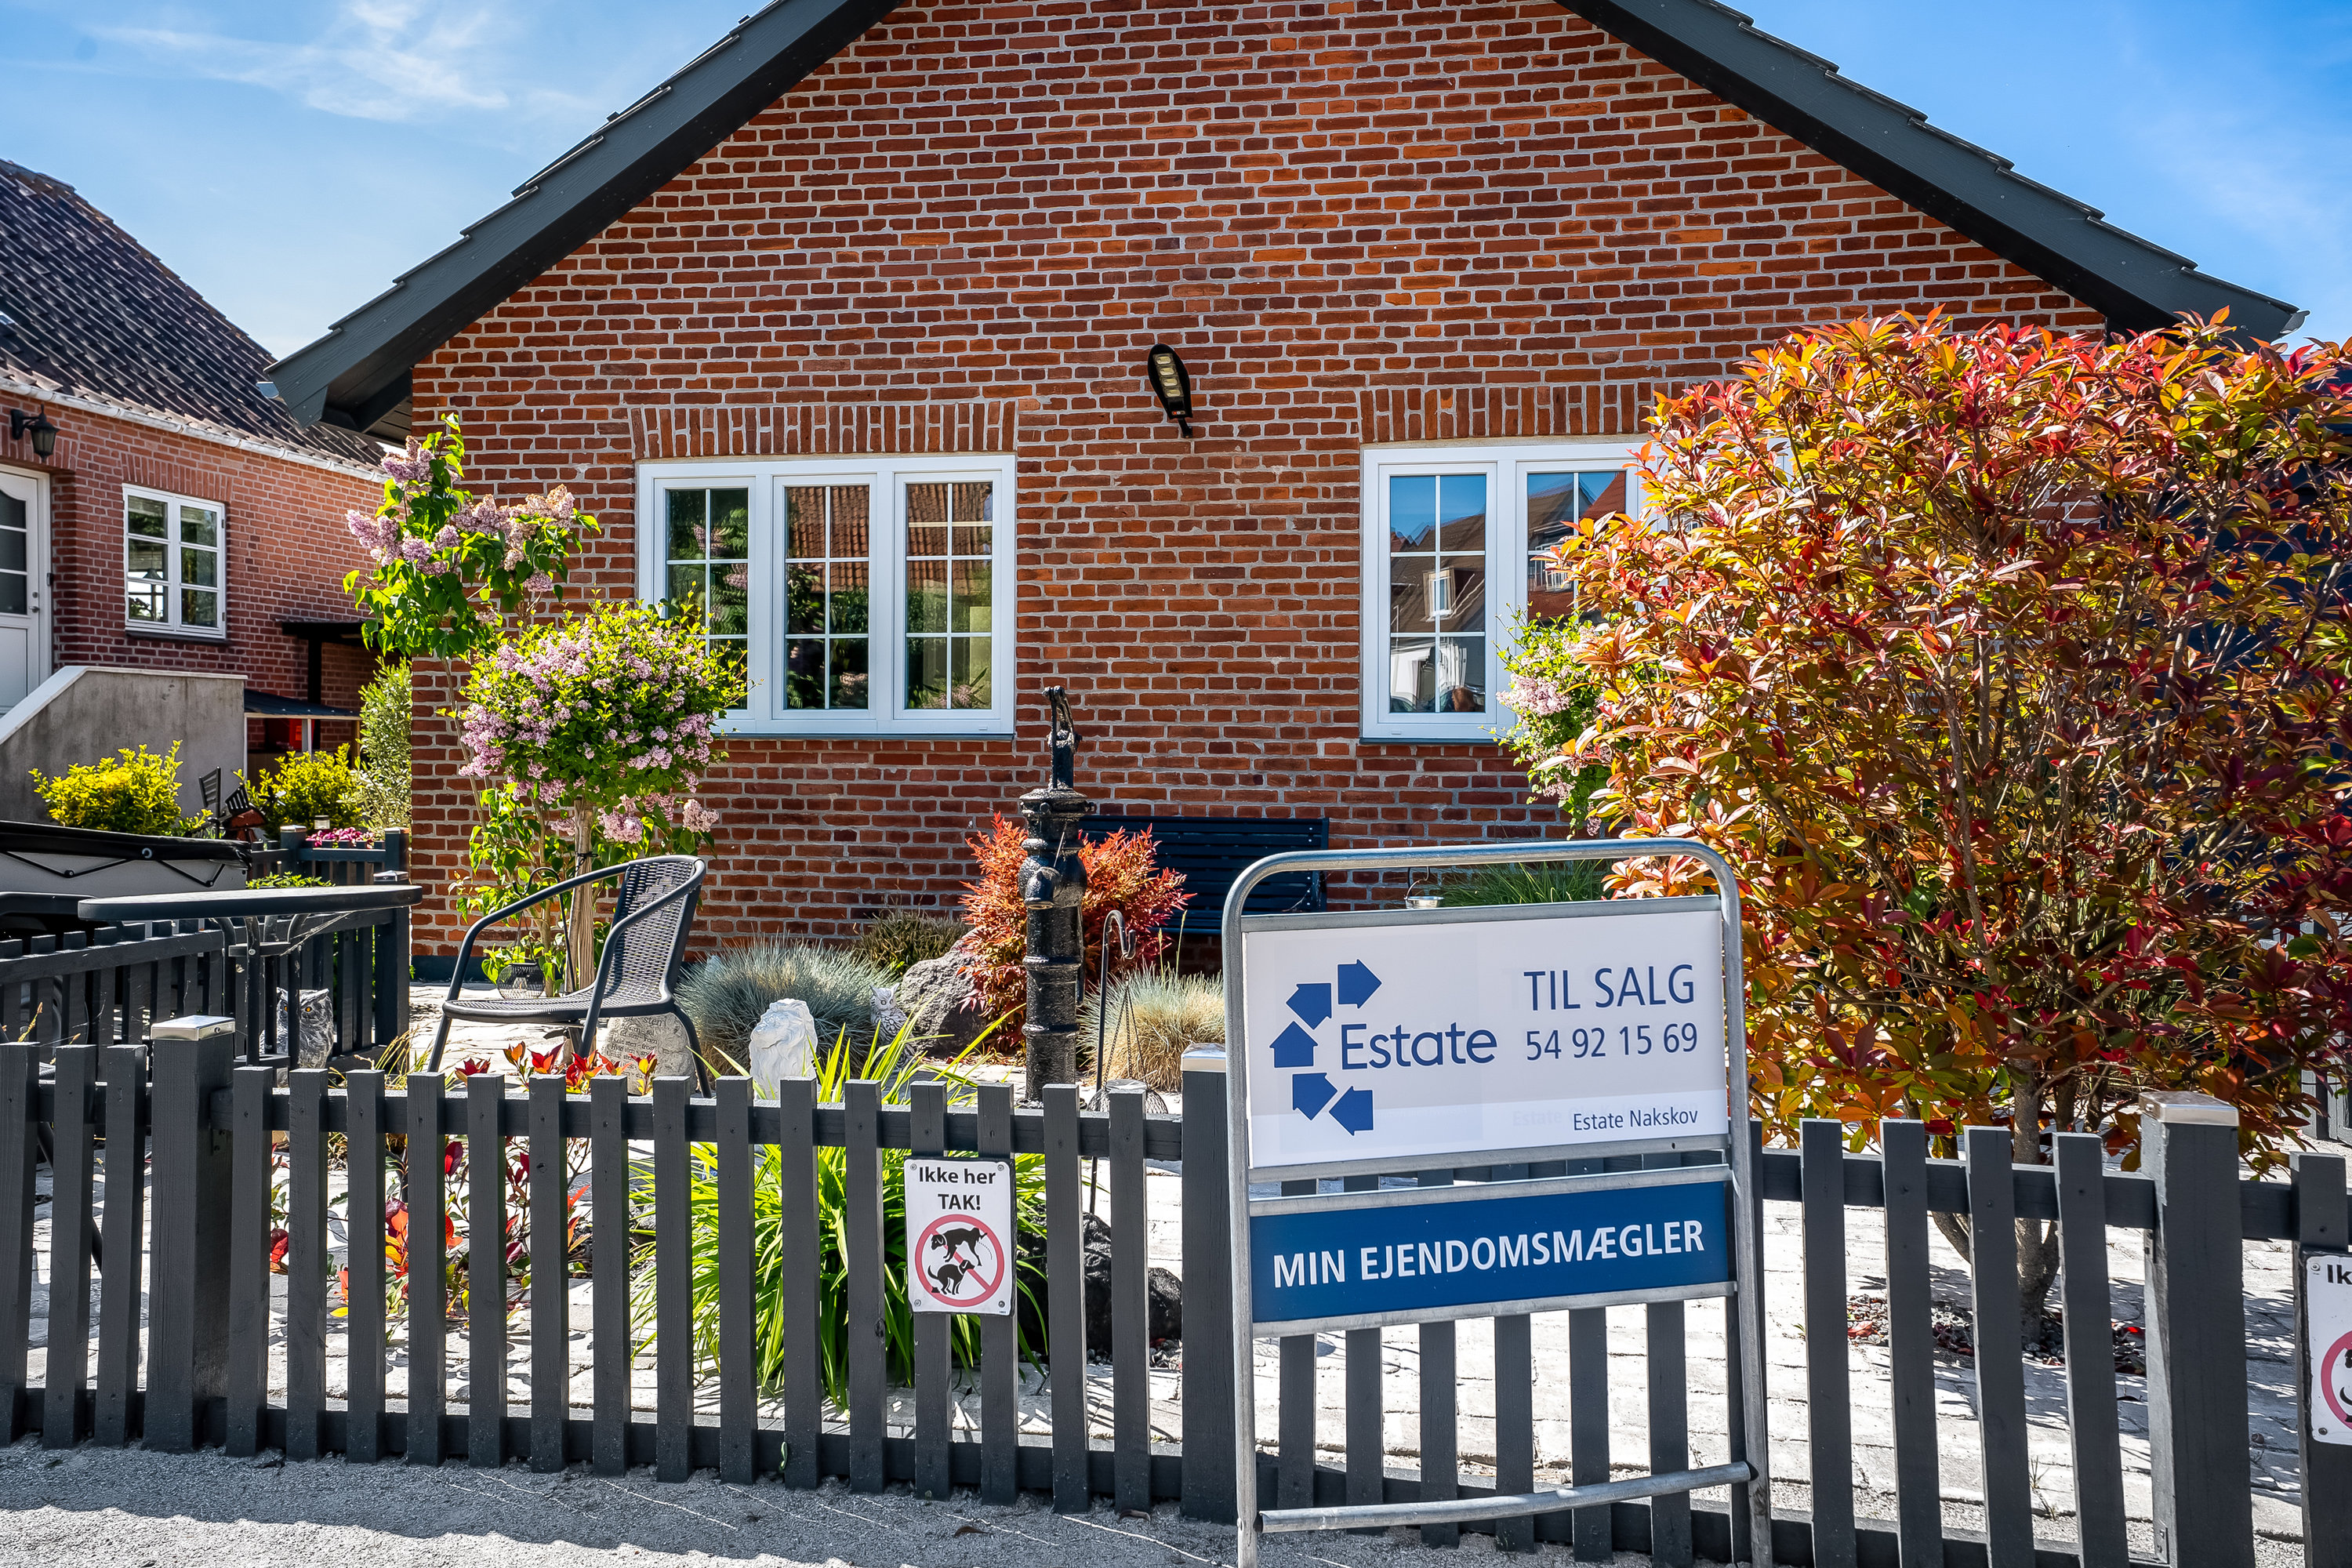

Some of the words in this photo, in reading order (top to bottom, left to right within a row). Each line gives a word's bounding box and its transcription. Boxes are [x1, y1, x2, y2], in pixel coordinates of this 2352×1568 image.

[1524, 971, 1581, 1011] TIL
[1595, 964, 1694, 1007] SALG
[1341, 1022, 1497, 1069] Estate
[1526, 1029, 1562, 1060] 54
[1572, 1028, 1606, 1058] 92
[1619, 1025, 1651, 1056] 15
[1663, 1022, 1697, 1053] 69
[1574, 1113, 1624, 1131] Estate
[1631, 1106, 1698, 1127] Nakskov
[920, 1167, 958, 1183] Ikke
[964, 1168, 996, 1184] her
[938, 1194, 981, 1210] TAK!
[1274, 1250, 1345, 1288] MIN
[1360, 1220, 1705, 1280] EJENDOMSMÆGLER
